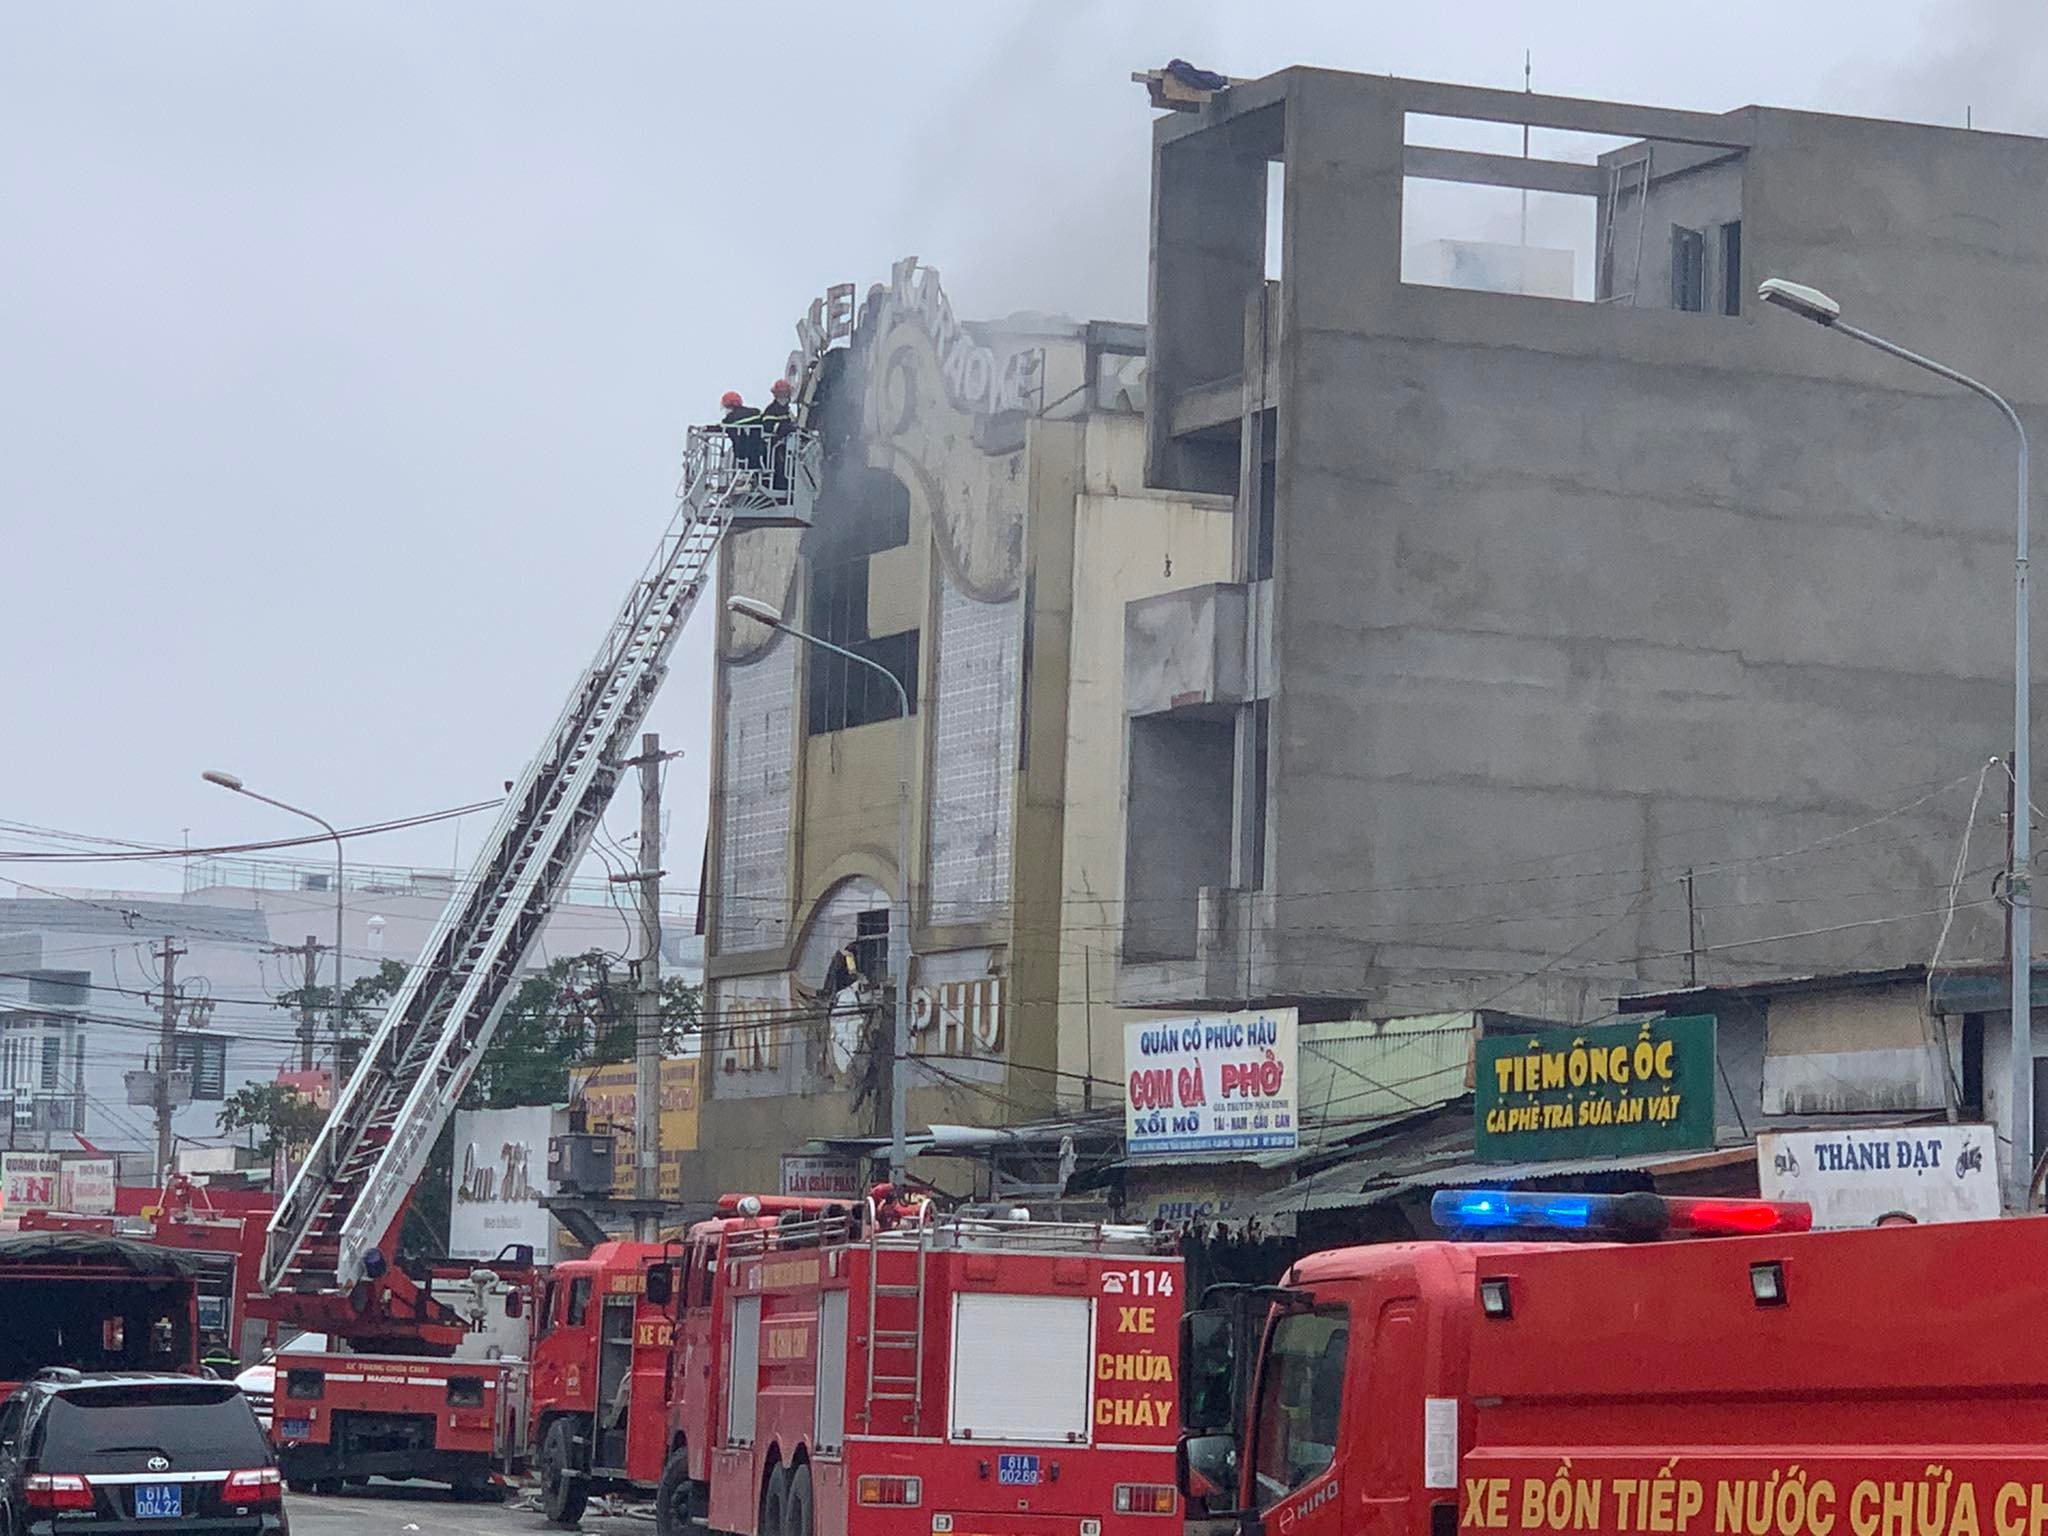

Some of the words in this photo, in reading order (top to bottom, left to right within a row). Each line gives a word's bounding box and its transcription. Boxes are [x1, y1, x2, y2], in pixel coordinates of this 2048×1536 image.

[1141, 1025, 1178, 1056] QUÁN
[1206, 1019, 1243, 1049] PHÚC
[1248, 1016, 1277, 1052] HẬU
[1495, 1039, 1566, 1098] TIỆM
[1568, 1037, 1629, 1087] ÔNG
[1633, 1022, 1674, 1080] ỐC
[1178, 1058, 1206, 1107] GÀ
[1221, 1049, 1284, 1098] PHỞ
[1134, 1111, 1166, 1135] XỐI
[1486, 1097, 1507, 1133] CÀ
[1543, 1093, 1574, 1129] TRÀ
[1578, 1090, 1612, 1126] SỮA
[1814, 1135, 1891, 1171] THÀNH
[1897, 1139, 1942, 1176] ĐẠT
[1129, 1269, 1174, 1297] 114
[639, 1325, 654, 1345] XE
[1118, 1307, 1155, 1333] XE
[1098, 1349, 1173, 1382] CHỮA
[1096, 1393, 1172, 1427] CHÁY
[1008, 1456, 1030, 1470] 61A
[146, 1486, 171, 1500] 61A
[1298, 1480, 1338, 1519] HINO
[1461, 1477, 1511, 1529] XE
[1521, 1456, 1601, 1529] BỒN
[1612, 1456, 1704, 1532] TIẾP
[1715, 1465, 1848, 1536] NƯỚC
[1849, 1464, 1980, 1536] CHỮA
